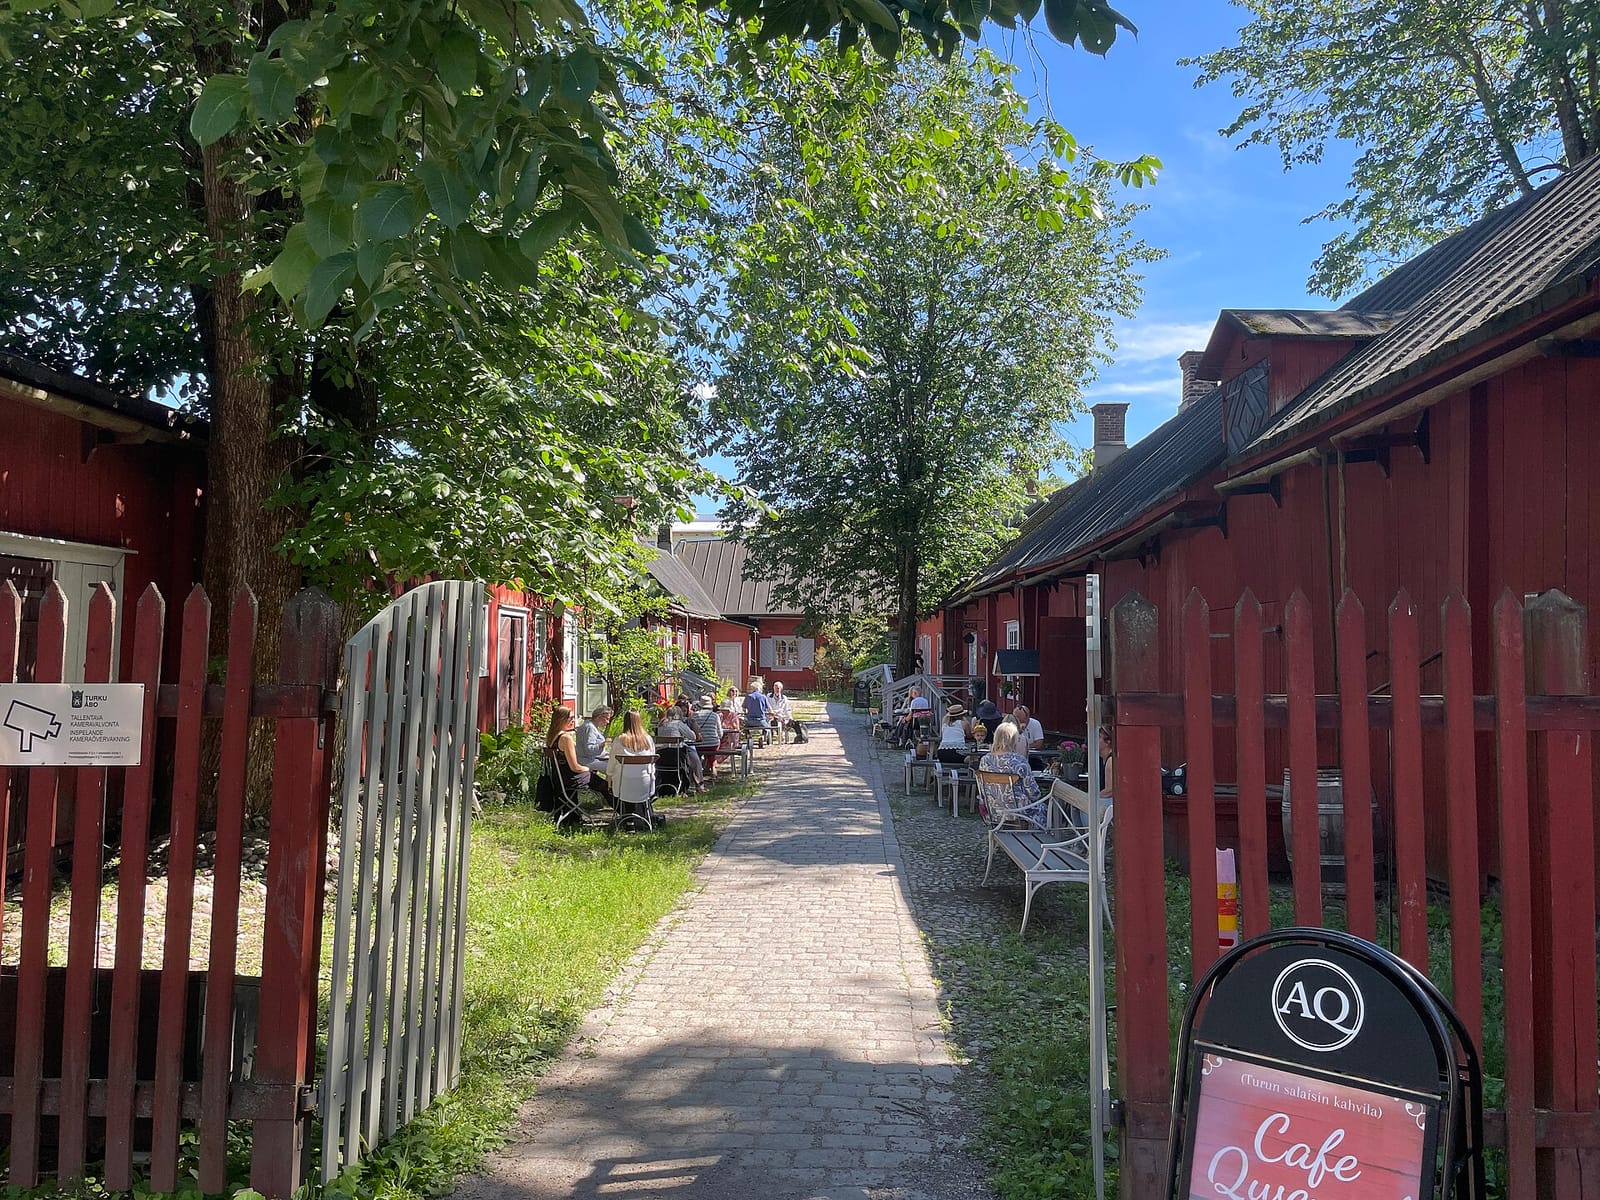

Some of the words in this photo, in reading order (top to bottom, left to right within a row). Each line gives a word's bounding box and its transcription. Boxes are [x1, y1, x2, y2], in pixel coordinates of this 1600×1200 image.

[1278, 981, 1356, 1035] AQ
[1240, 1073, 1280, 1093] (Turun
[1284, 1085, 1330, 1105] salaisin
[1333, 1095, 1383, 1120] kahvila)
[1254, 1112, 1362, 1189] Cafe
